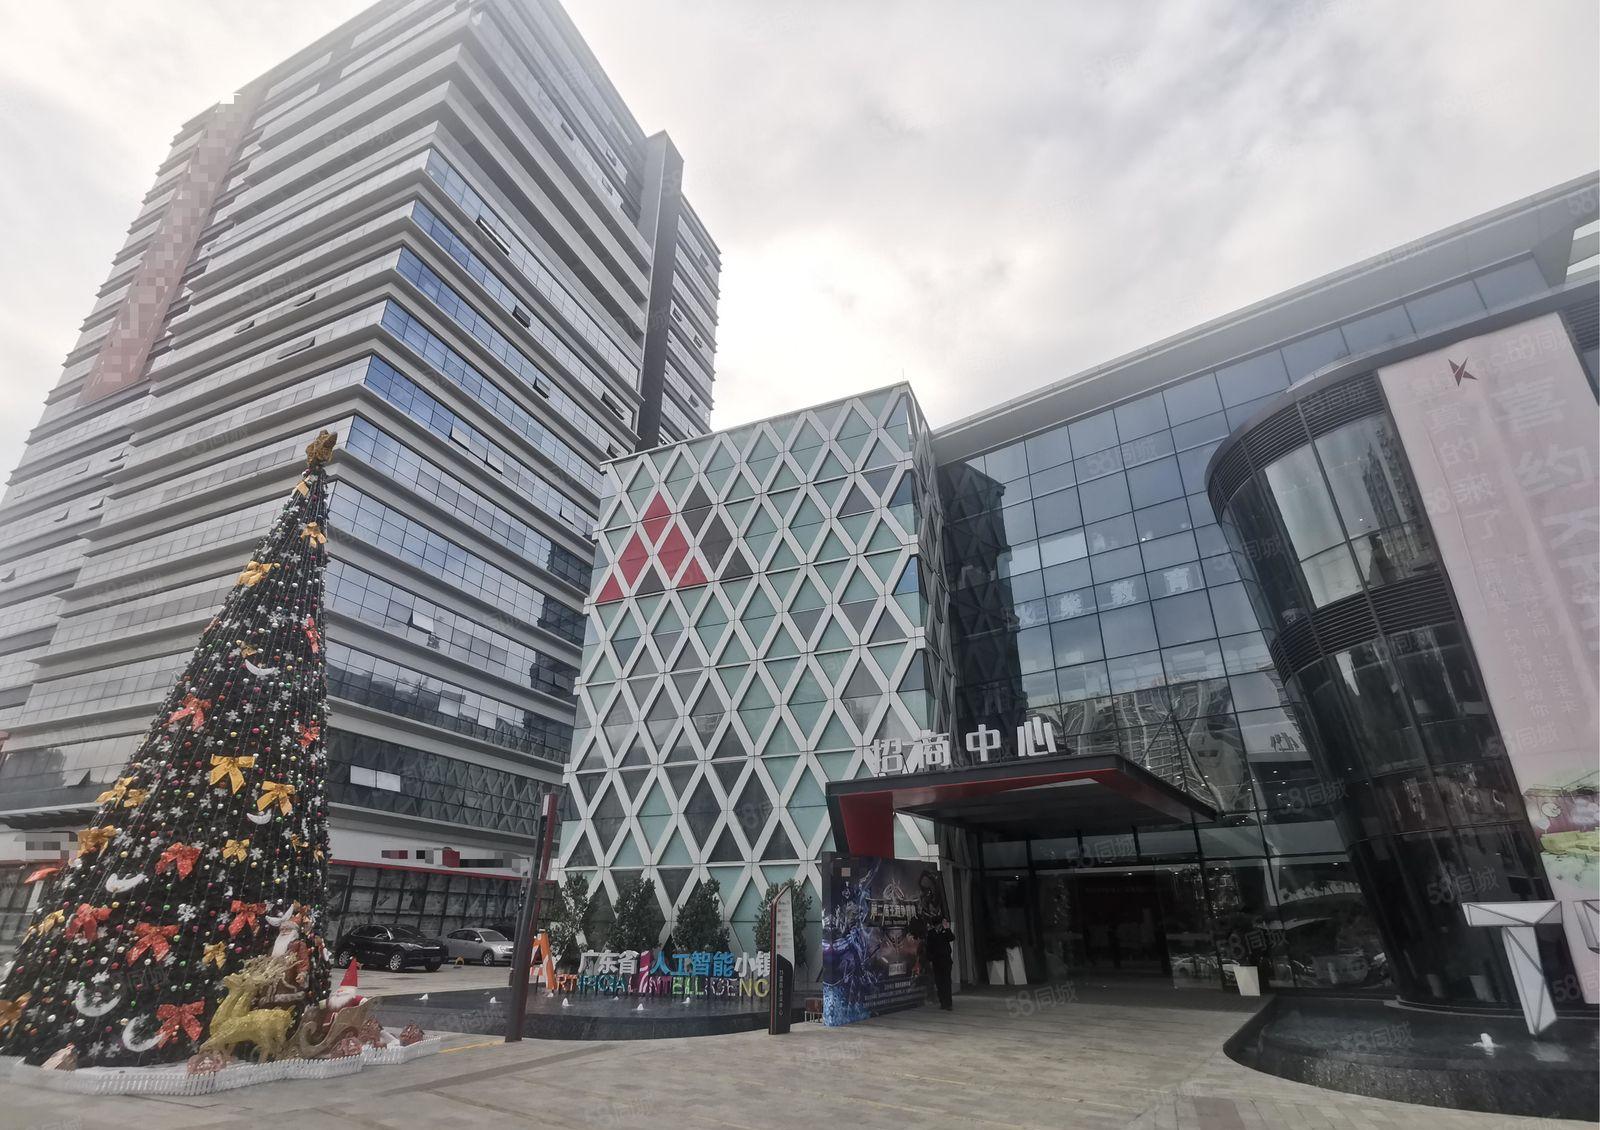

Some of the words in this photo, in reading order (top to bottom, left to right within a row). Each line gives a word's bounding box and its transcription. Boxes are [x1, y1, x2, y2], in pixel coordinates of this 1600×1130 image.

[872, 716, 1057, 776] 招商中心
[639, 951, 769, 997] INTELLIGENC
